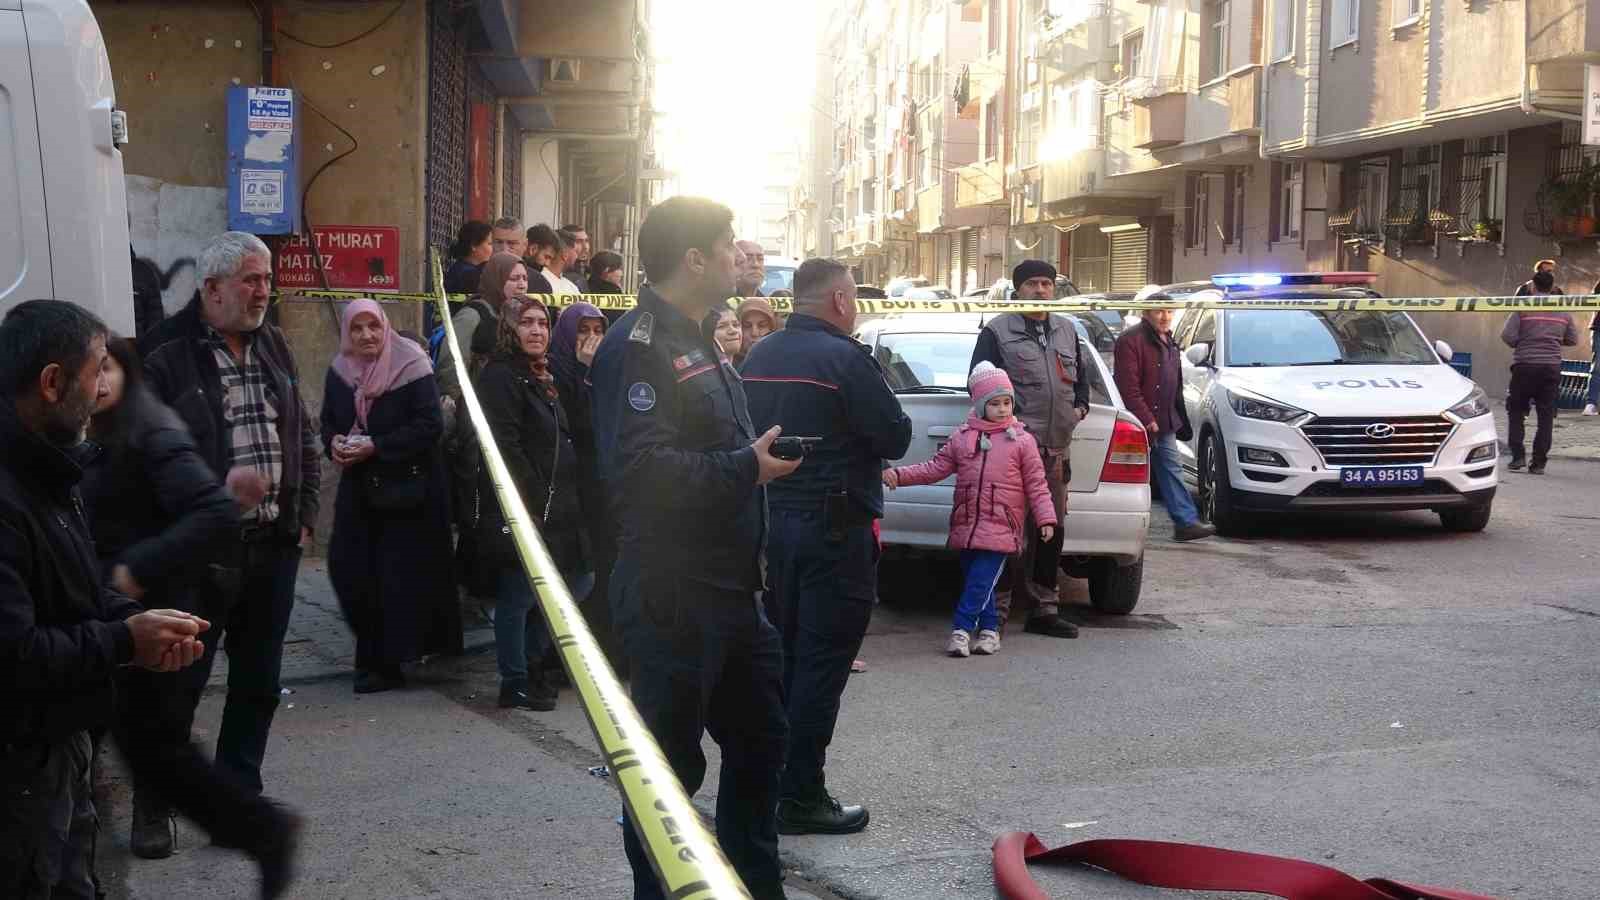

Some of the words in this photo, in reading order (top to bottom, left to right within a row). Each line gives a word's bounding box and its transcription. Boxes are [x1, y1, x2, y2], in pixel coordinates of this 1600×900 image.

[280, 232, 324, 248] ŞEHT
[329, 232, 383, 248] MURAT
[279, 254, 334, 270] MATUZ
[1345, 470, 1361, 482] 34
[1365, 470, 1376, 482] A
[1378, 469, 1419, 481] 95153
